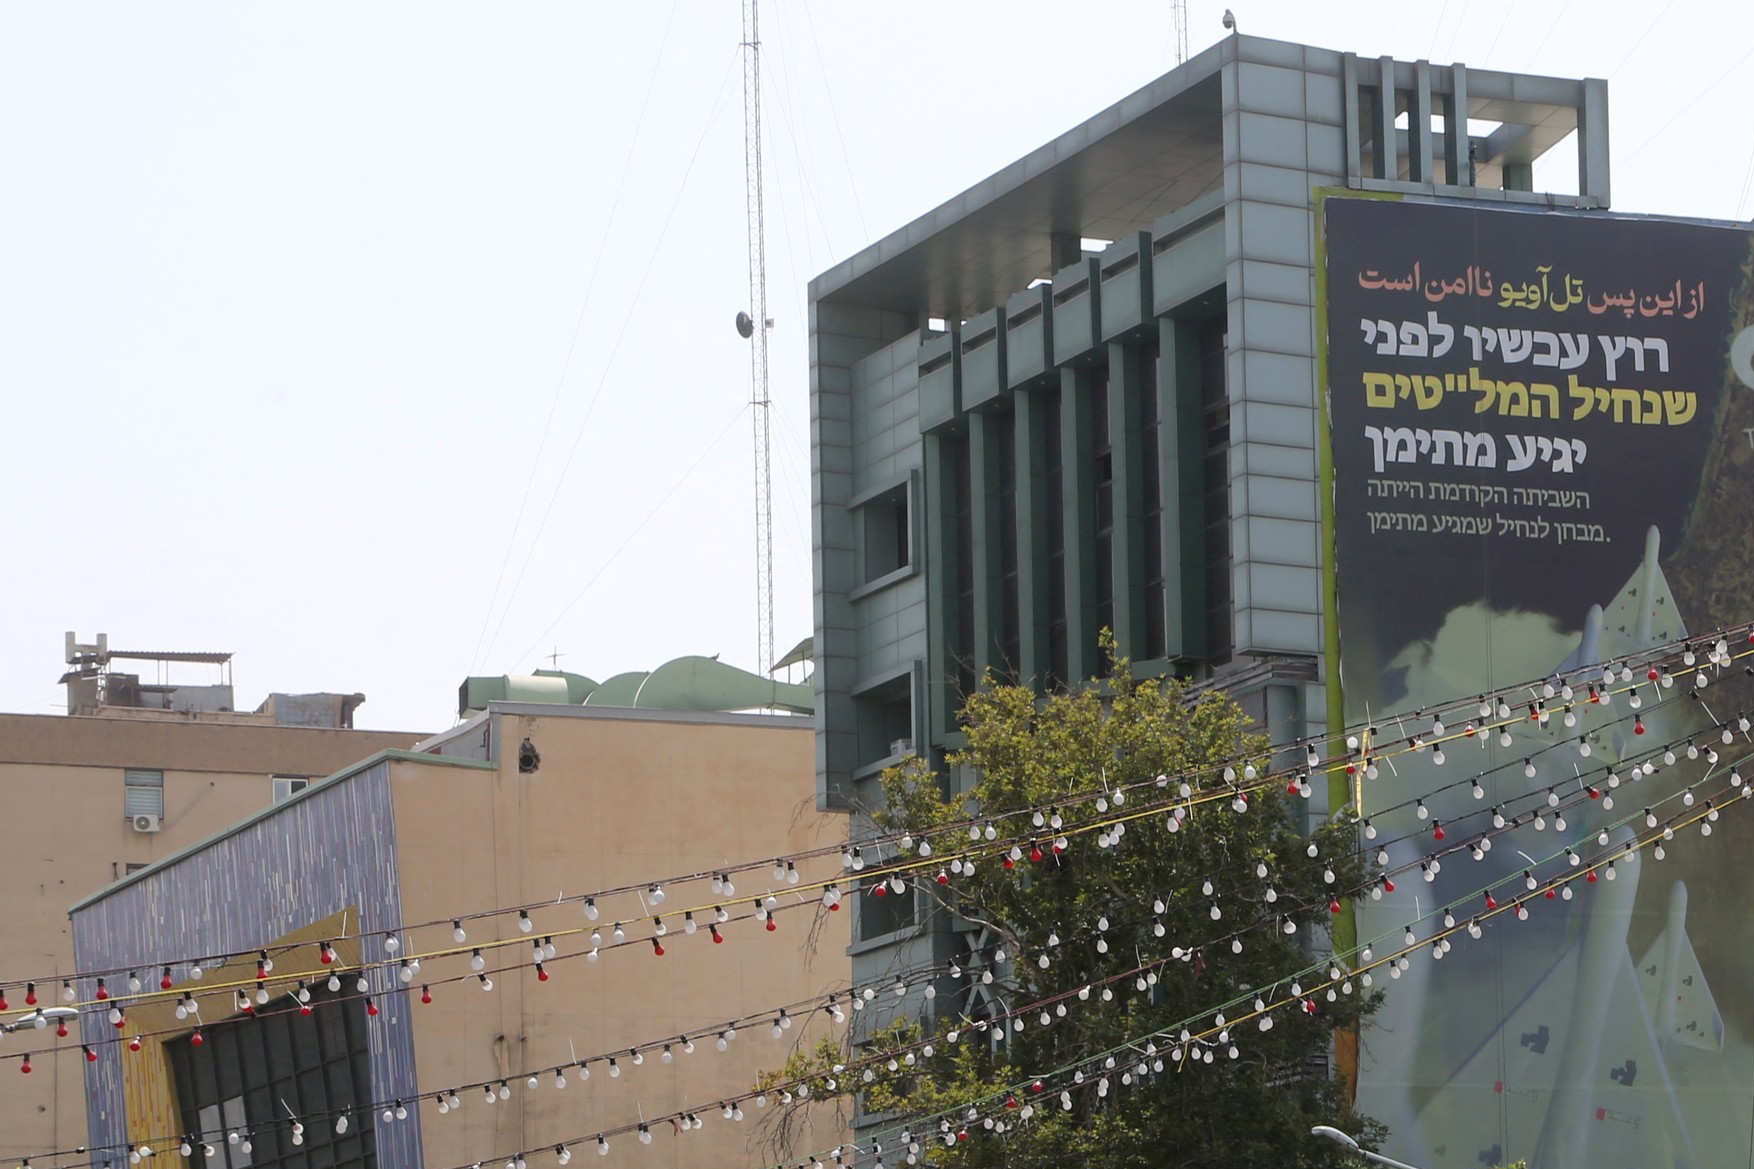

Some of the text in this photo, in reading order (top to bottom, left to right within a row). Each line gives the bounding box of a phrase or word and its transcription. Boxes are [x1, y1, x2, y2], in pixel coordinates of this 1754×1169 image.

[1358, 261, 1704, 319] از این پس تل آویو ناامن است
[1360, 311, 1669, 381] רוץ עכשיו לפני
[1567, 374, 1697, 426] שנחיל
[1364, 425, 1588, 474] יגיע מתימן
[1367, 479, 1590, 509] השביתה הקודמת הייתה
[1366, 511, 1427, 534] מתימן
[1432, 514, 1492, 535] שמגיע
[1496, 513, 1550, 539] לנחיל
